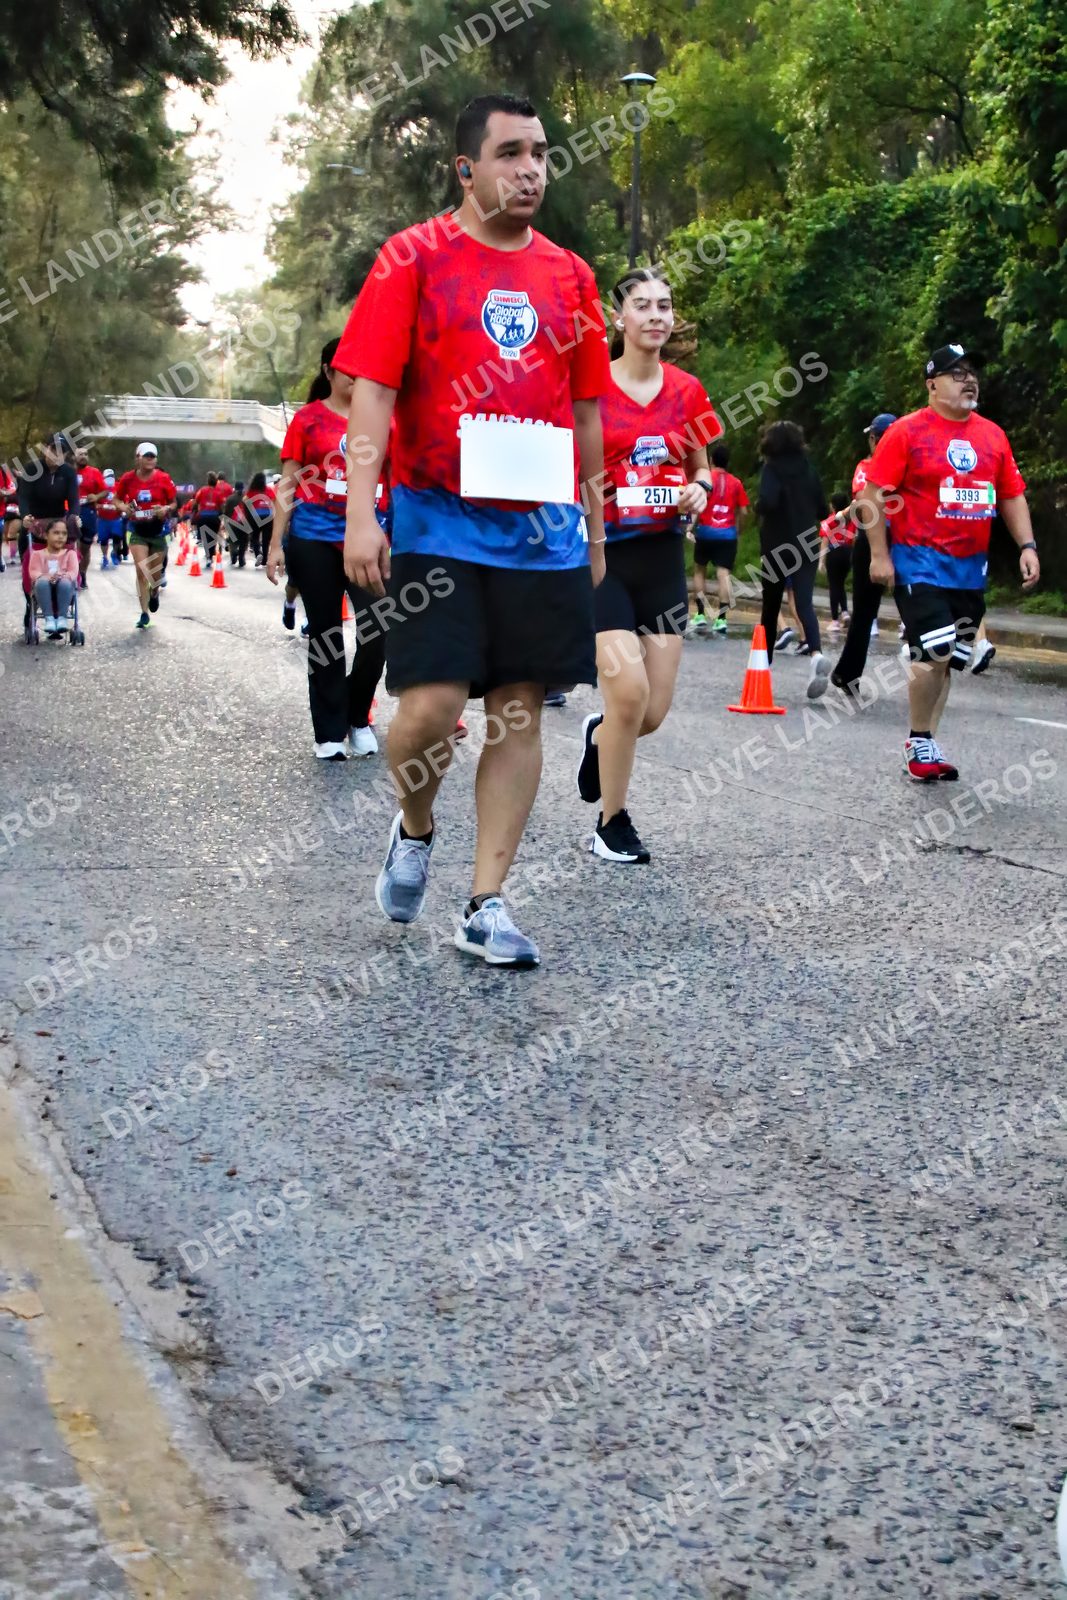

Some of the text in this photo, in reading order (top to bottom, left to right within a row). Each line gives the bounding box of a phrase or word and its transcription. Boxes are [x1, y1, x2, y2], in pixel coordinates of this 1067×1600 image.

[495, 305, 524, 317] Global
[490, 313, 512, 325] Race
[644, 488, 673, 504] 2571
[955, 489, 980, 502] 3393
